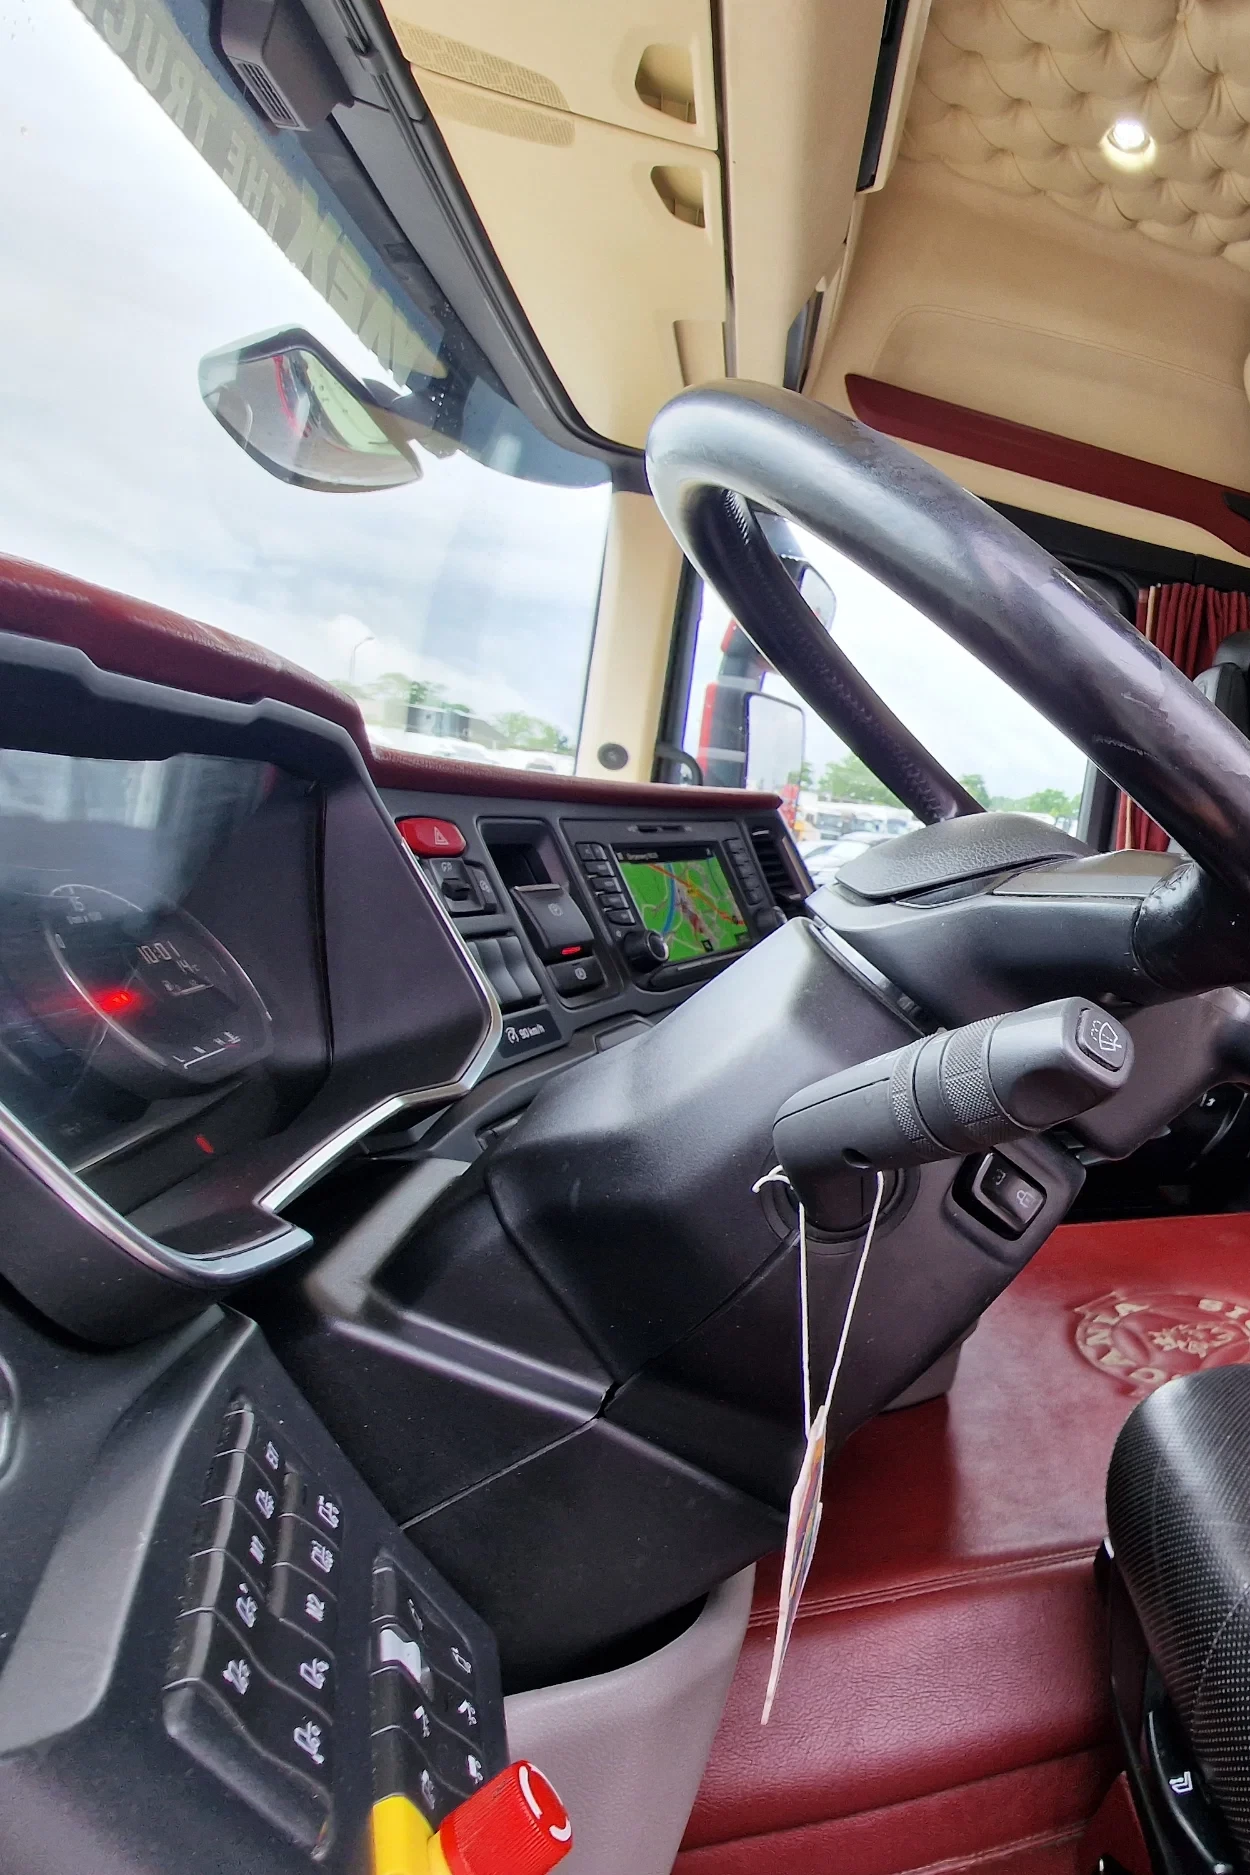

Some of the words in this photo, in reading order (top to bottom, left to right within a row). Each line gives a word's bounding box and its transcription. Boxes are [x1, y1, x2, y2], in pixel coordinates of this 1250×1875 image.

[136, 940, 181, 965] 10:01
[518, 1027, 530, 1039] 90
[1086, 1303, 1183, 1385] CANIA
